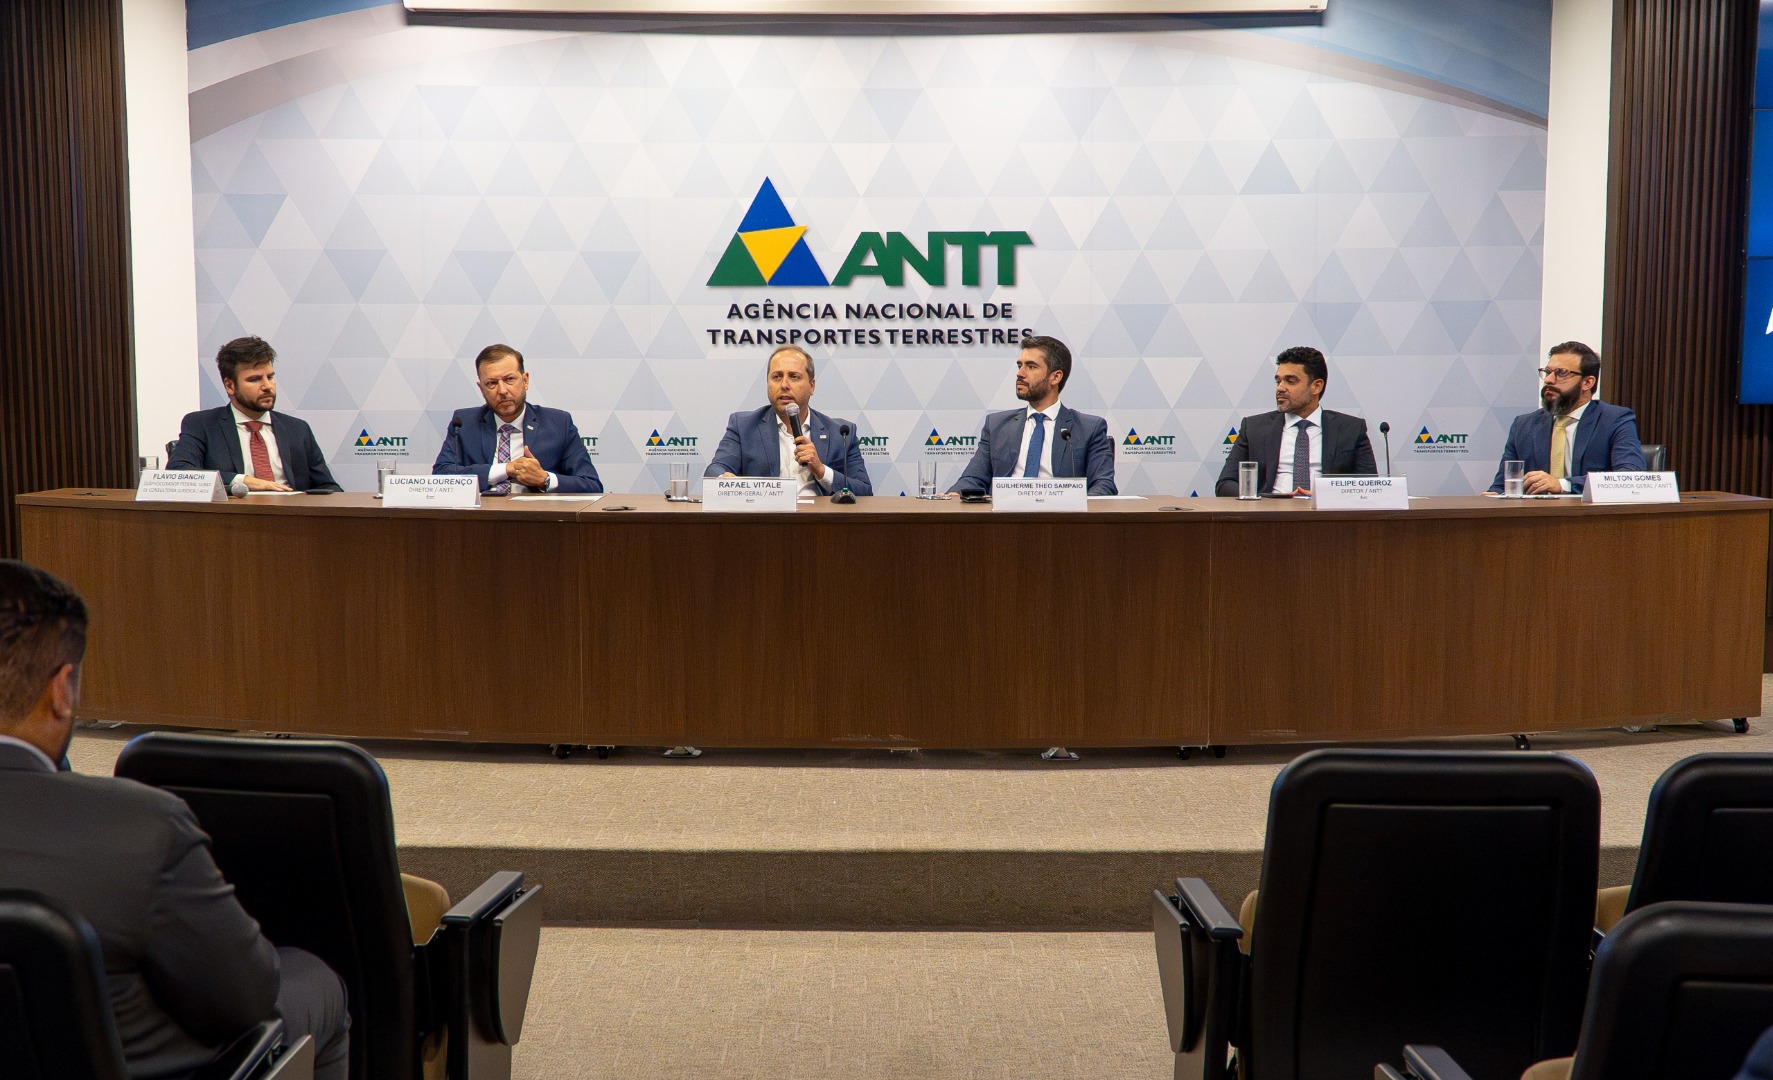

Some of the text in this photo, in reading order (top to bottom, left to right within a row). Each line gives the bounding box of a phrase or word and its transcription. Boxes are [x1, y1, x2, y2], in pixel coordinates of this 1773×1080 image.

[830, 231, 1034, 286] ANTT
[726, 298, 1013, 319] AGÊNCIA NACIONAL DE
[707, 328, 881, 345] TRANSPORTES
[375, 437, 408, 446] ANTT
[666, 437, 698, 446] ANTT
[859, 436, 889, 446] ANTT
[945, 436, 977, 446] ANTT
[1142, 436, 1176, 445] ANTT
[1434, 434, 1469, 443] ANTT
